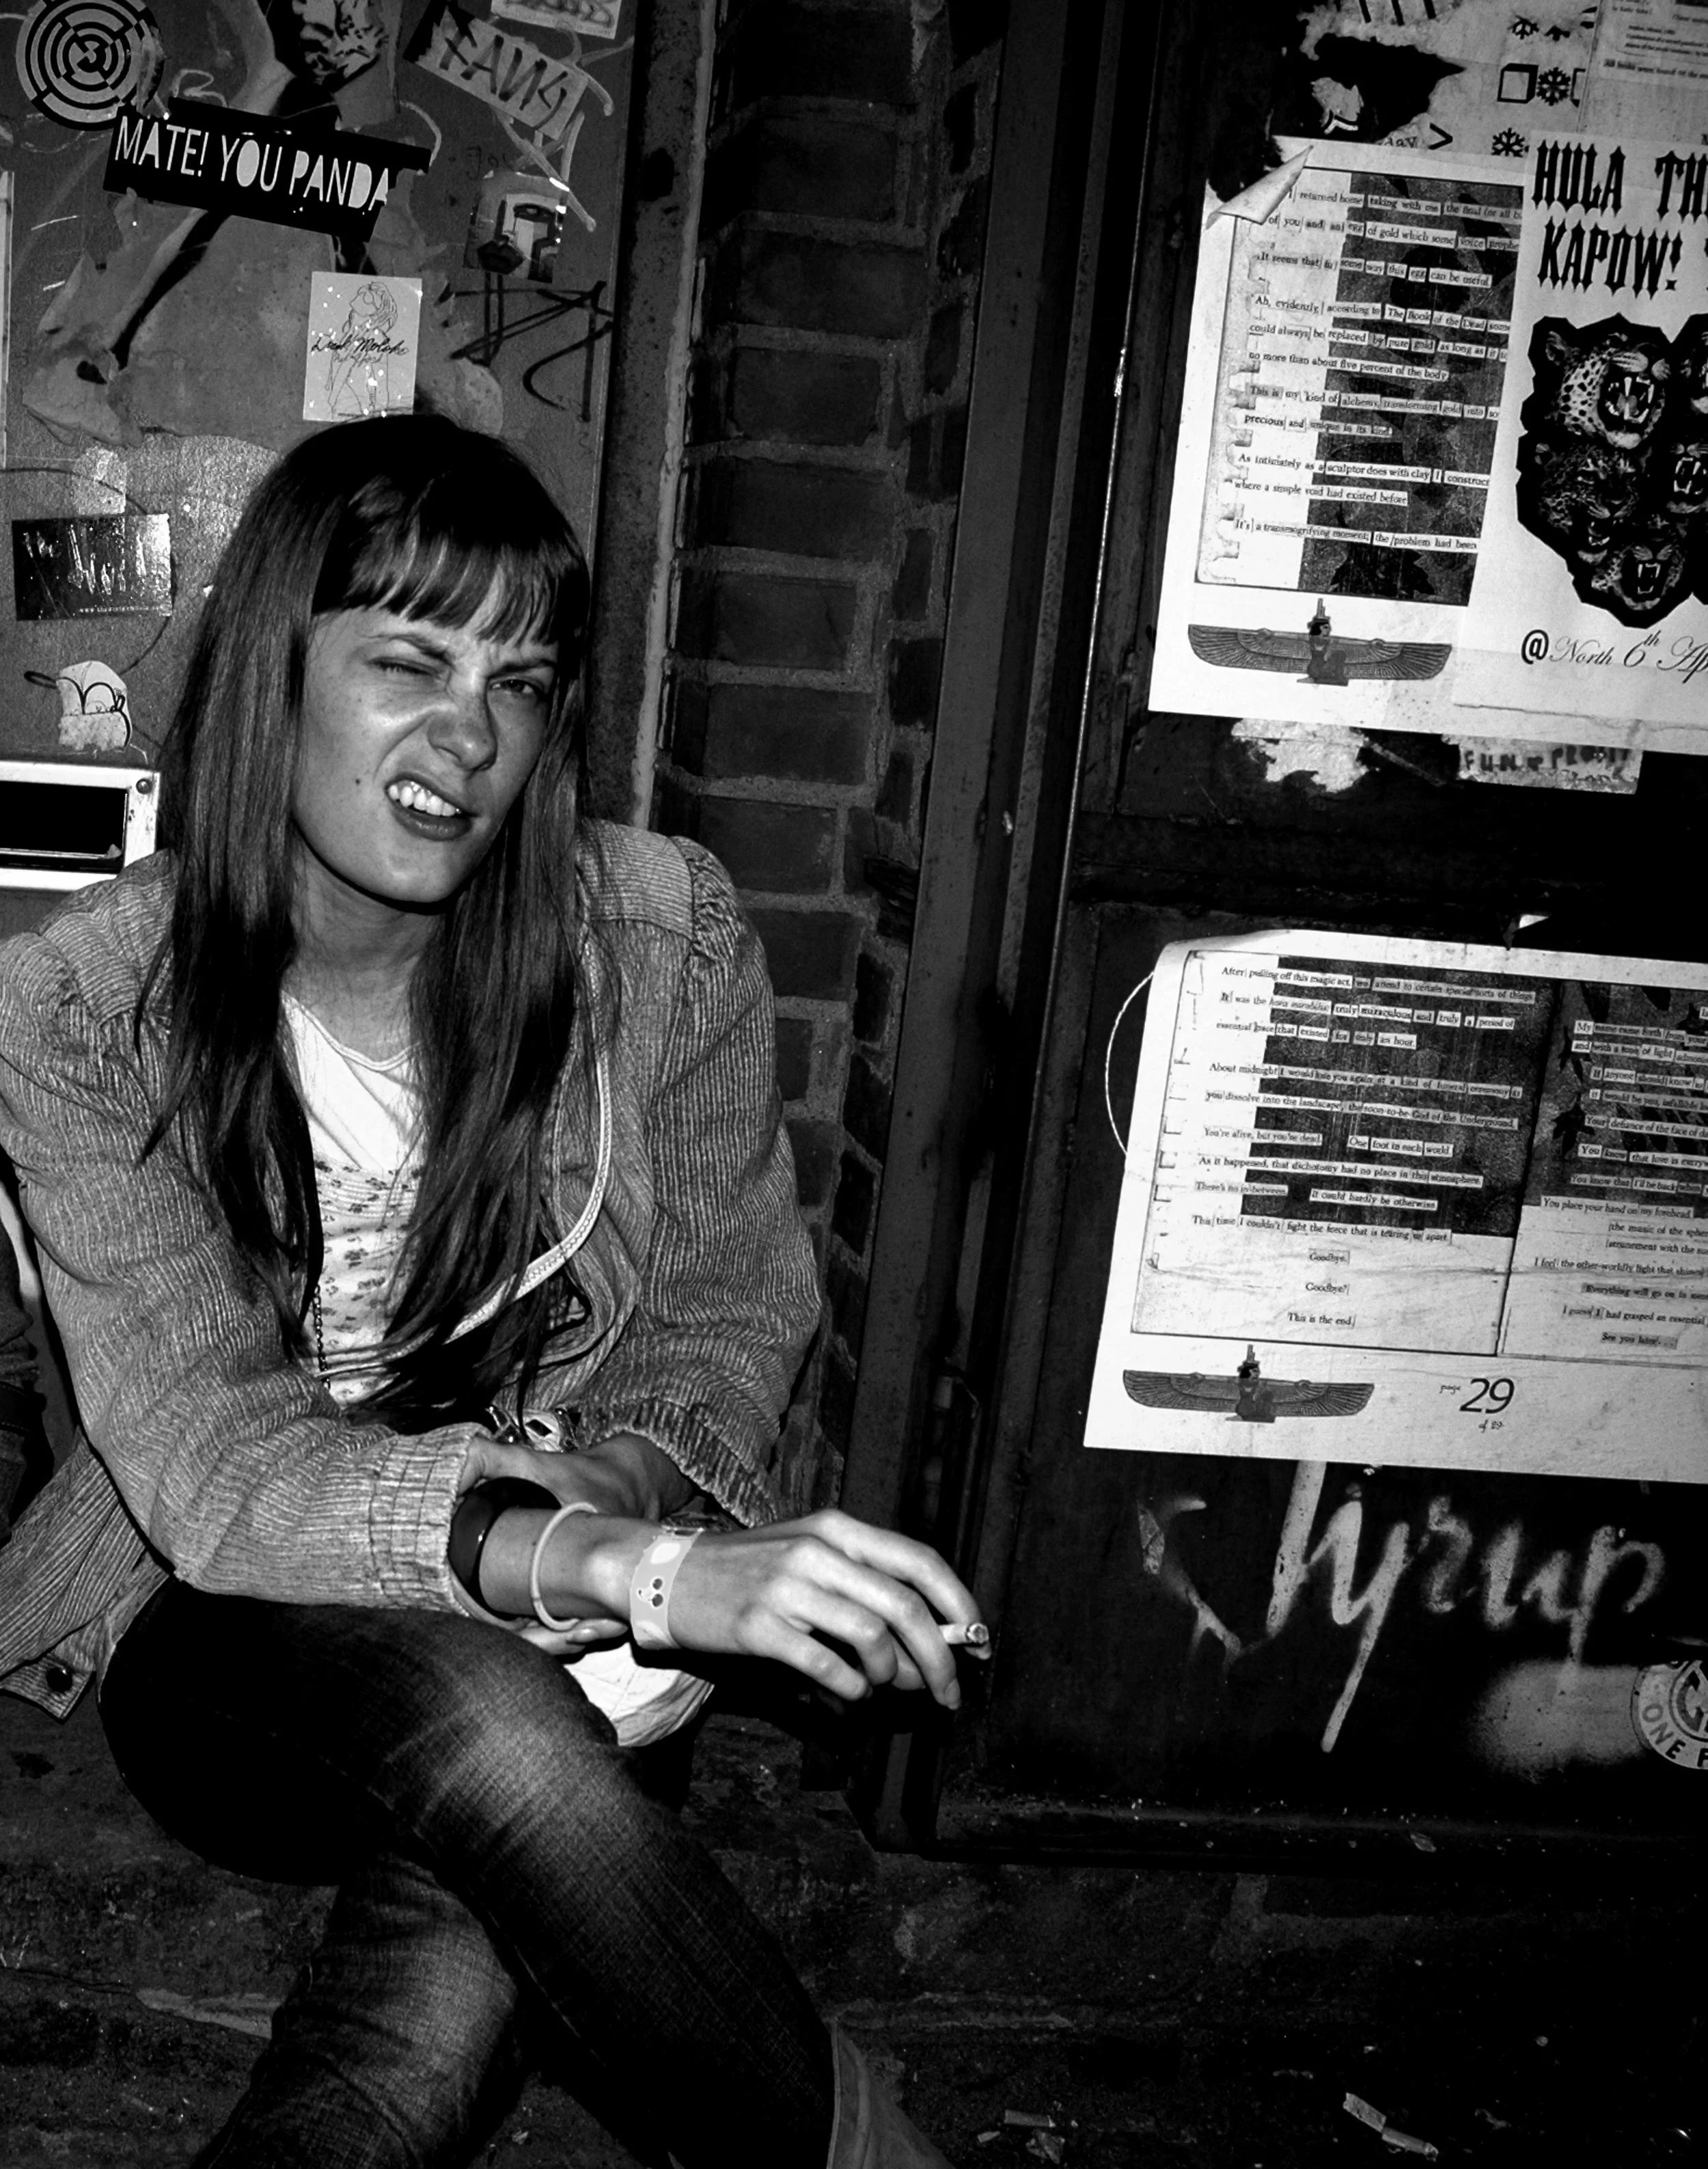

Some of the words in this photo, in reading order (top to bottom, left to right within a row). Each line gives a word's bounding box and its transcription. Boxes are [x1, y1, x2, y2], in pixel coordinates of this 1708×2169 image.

[115, 115, 209, 177] MATE!
[221, 135, 283, 192] YOU
[289, 150, 389, 211] PANDA
[1531, 139, 1626, 217] HULA
[1654, 150, 1708, 224] TH
[1269, 216, 1278, 225] of
[1379, 228, 1399, 239] gold
[1537, 215, 1683, 301] KAPOW!
[1329, 329, 1366, 343] replaced
[1452, 342, 1472, 355] long
[1408, 364, 1422, 376] the
[1424, 366, 1446, 380] body
[1328, 463, 1365, 478] sculptor
[1390, 466, 1409, 477] with
[1411, 467, 1430, 480] clay
[1549, 636, 1614, 666] North
[1349, 1138, 1367, 1146] One
[1582, 1146, 1599, 1155] You
[1459, 1378, 1515, 1414] 29
[1642, 1703, 1686, 1760] ONE
